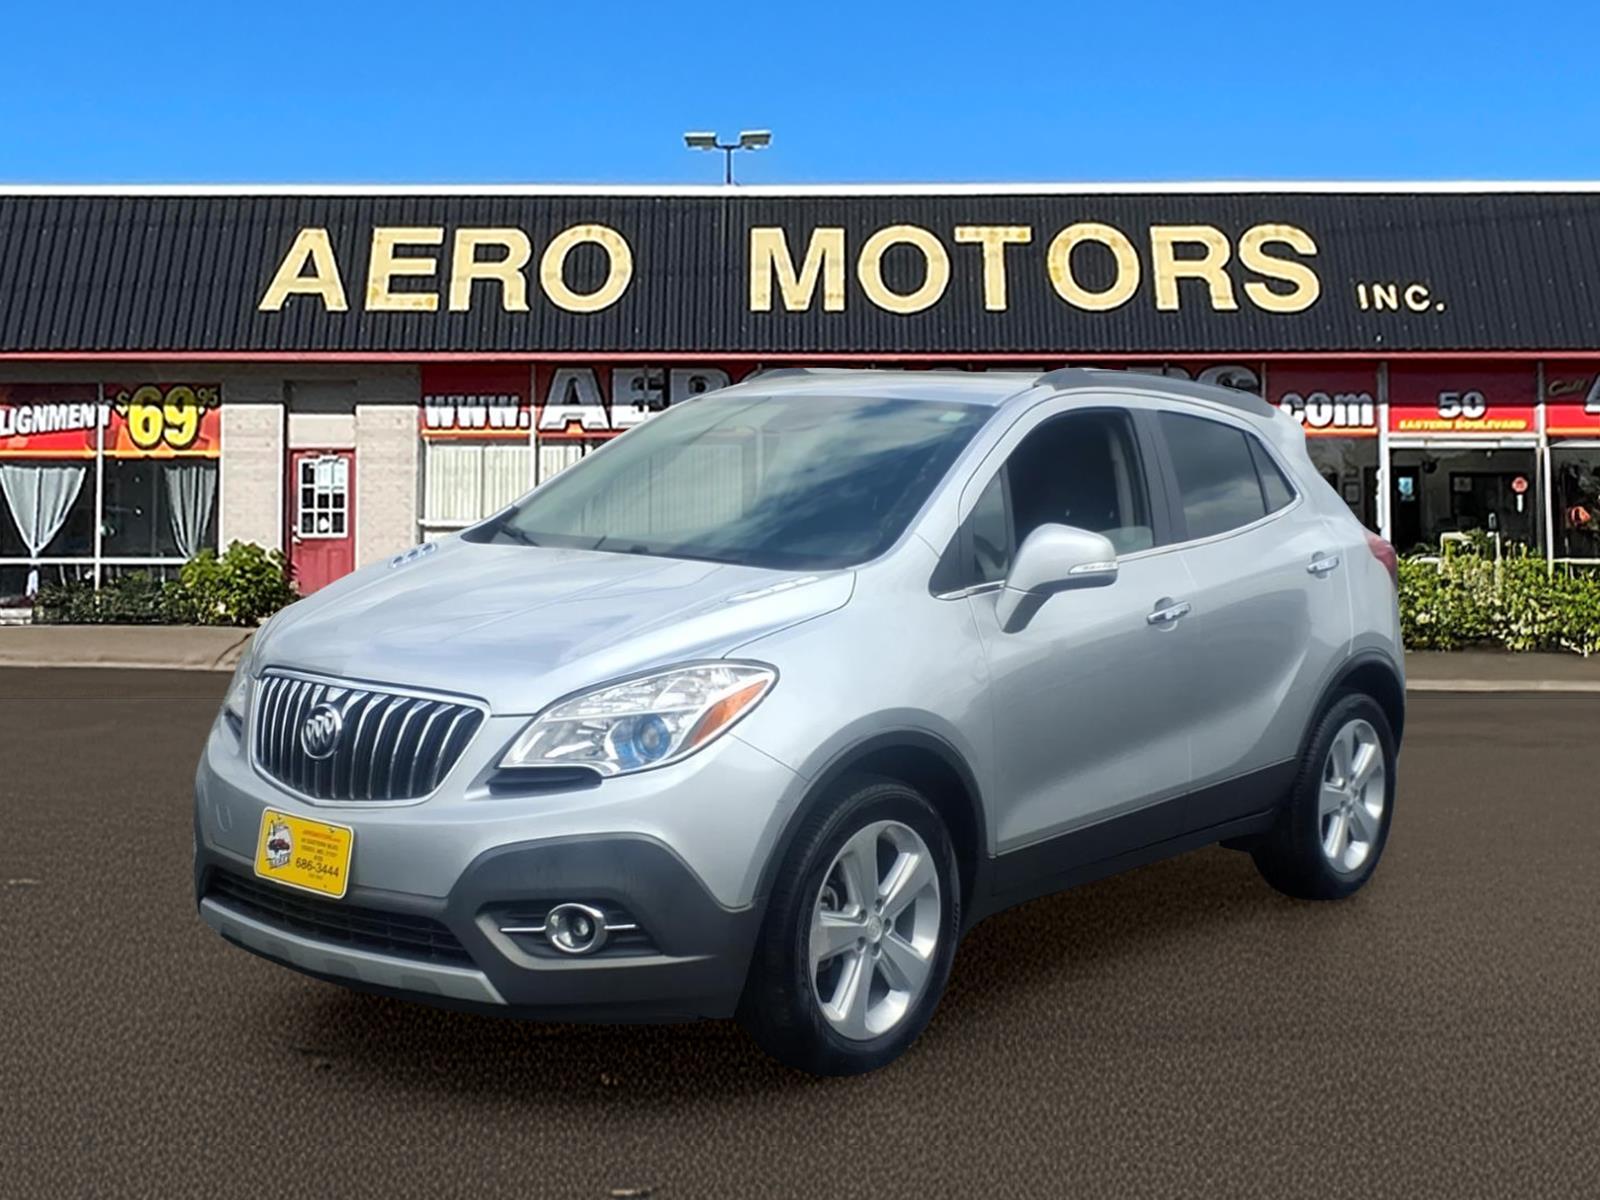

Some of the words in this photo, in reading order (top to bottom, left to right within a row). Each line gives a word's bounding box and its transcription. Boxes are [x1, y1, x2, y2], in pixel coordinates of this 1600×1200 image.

[258, 224, 633, 313] AERO
[750, 222, 1320, 314] MOTORS
[1357, 283, 1445, 312] INC.
[423, 395, 530, 428] www.
[1438, 391, 1486, 419] 50
[296, 856, 339, 877] 686-3444
